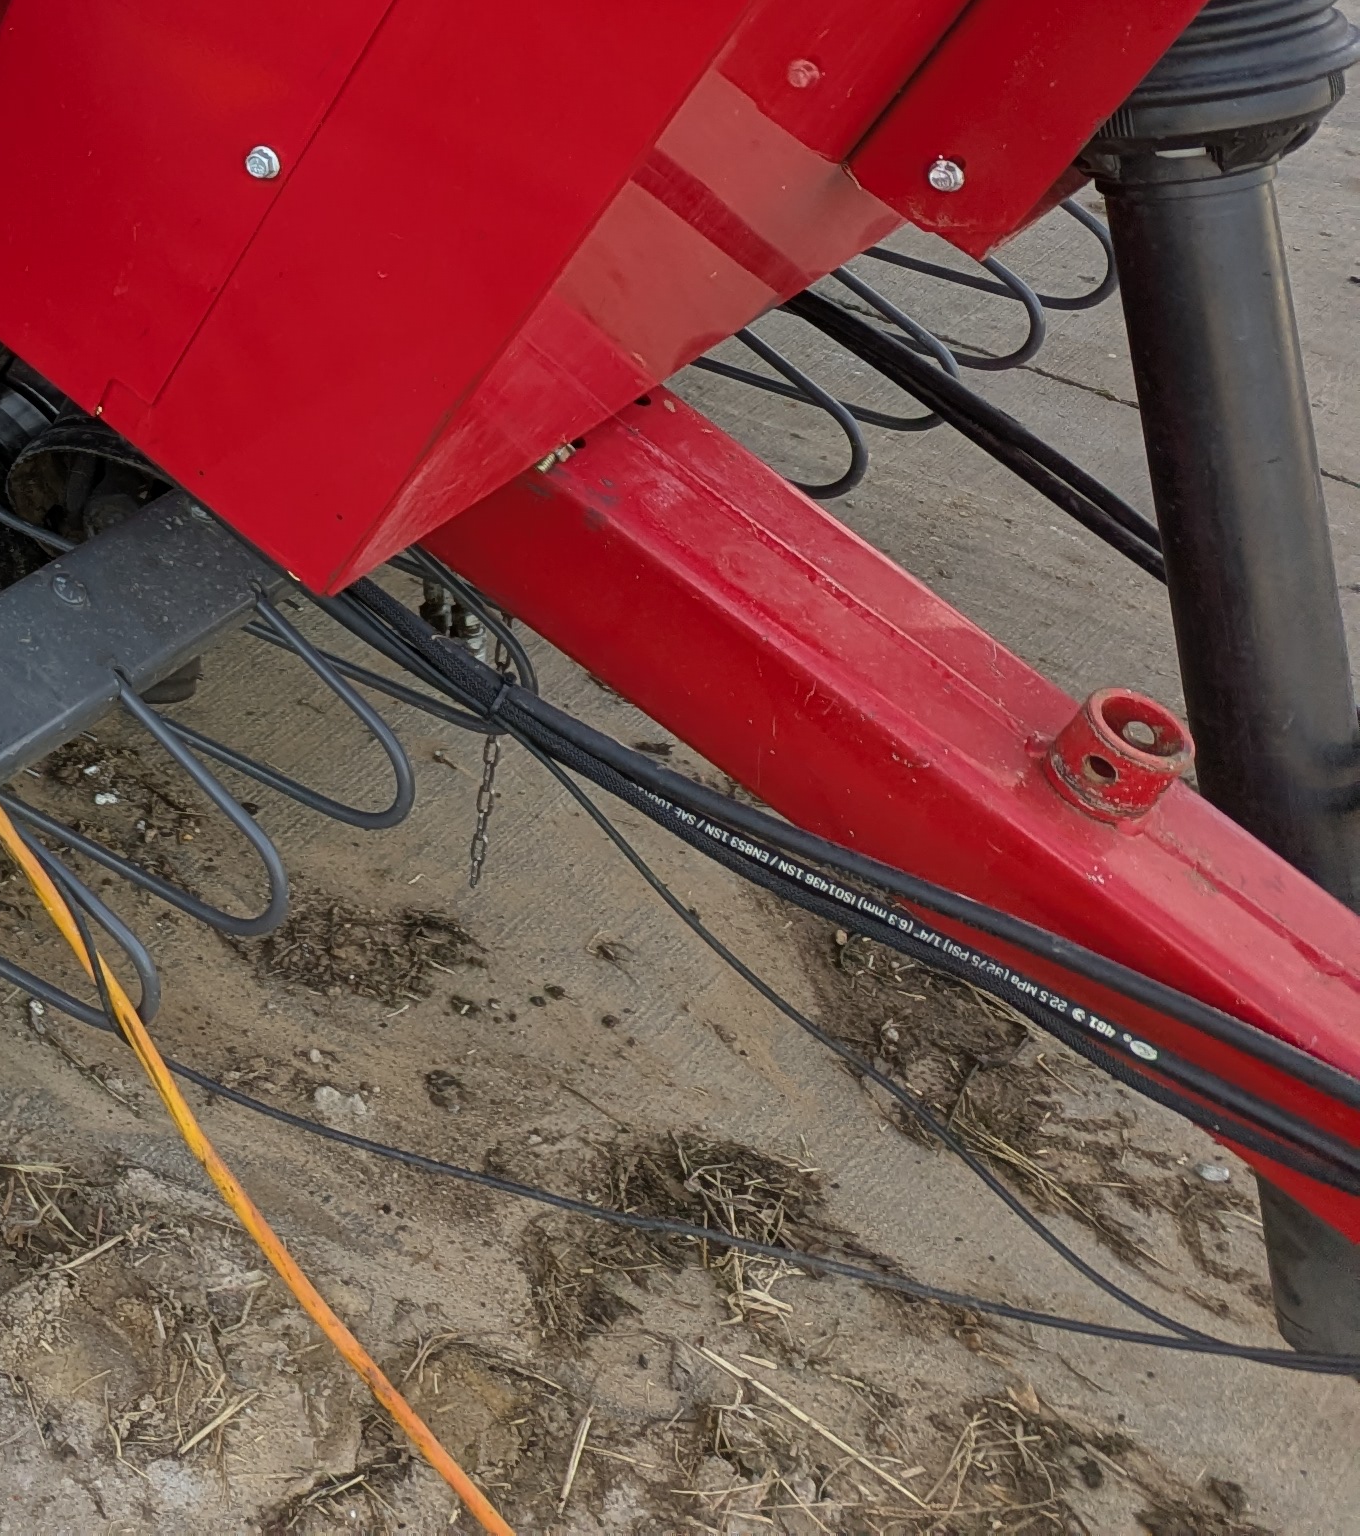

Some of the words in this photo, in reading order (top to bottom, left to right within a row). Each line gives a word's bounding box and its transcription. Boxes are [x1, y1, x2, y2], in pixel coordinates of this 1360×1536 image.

[704, 822, 731, 844] 1SN
[729, 835, 770, 863] EN853
[777, 858, 805, 881] 1SN
[1010, 975, 1038, 998] MPa
[1038, 990, 1068, 1013] 22.5
